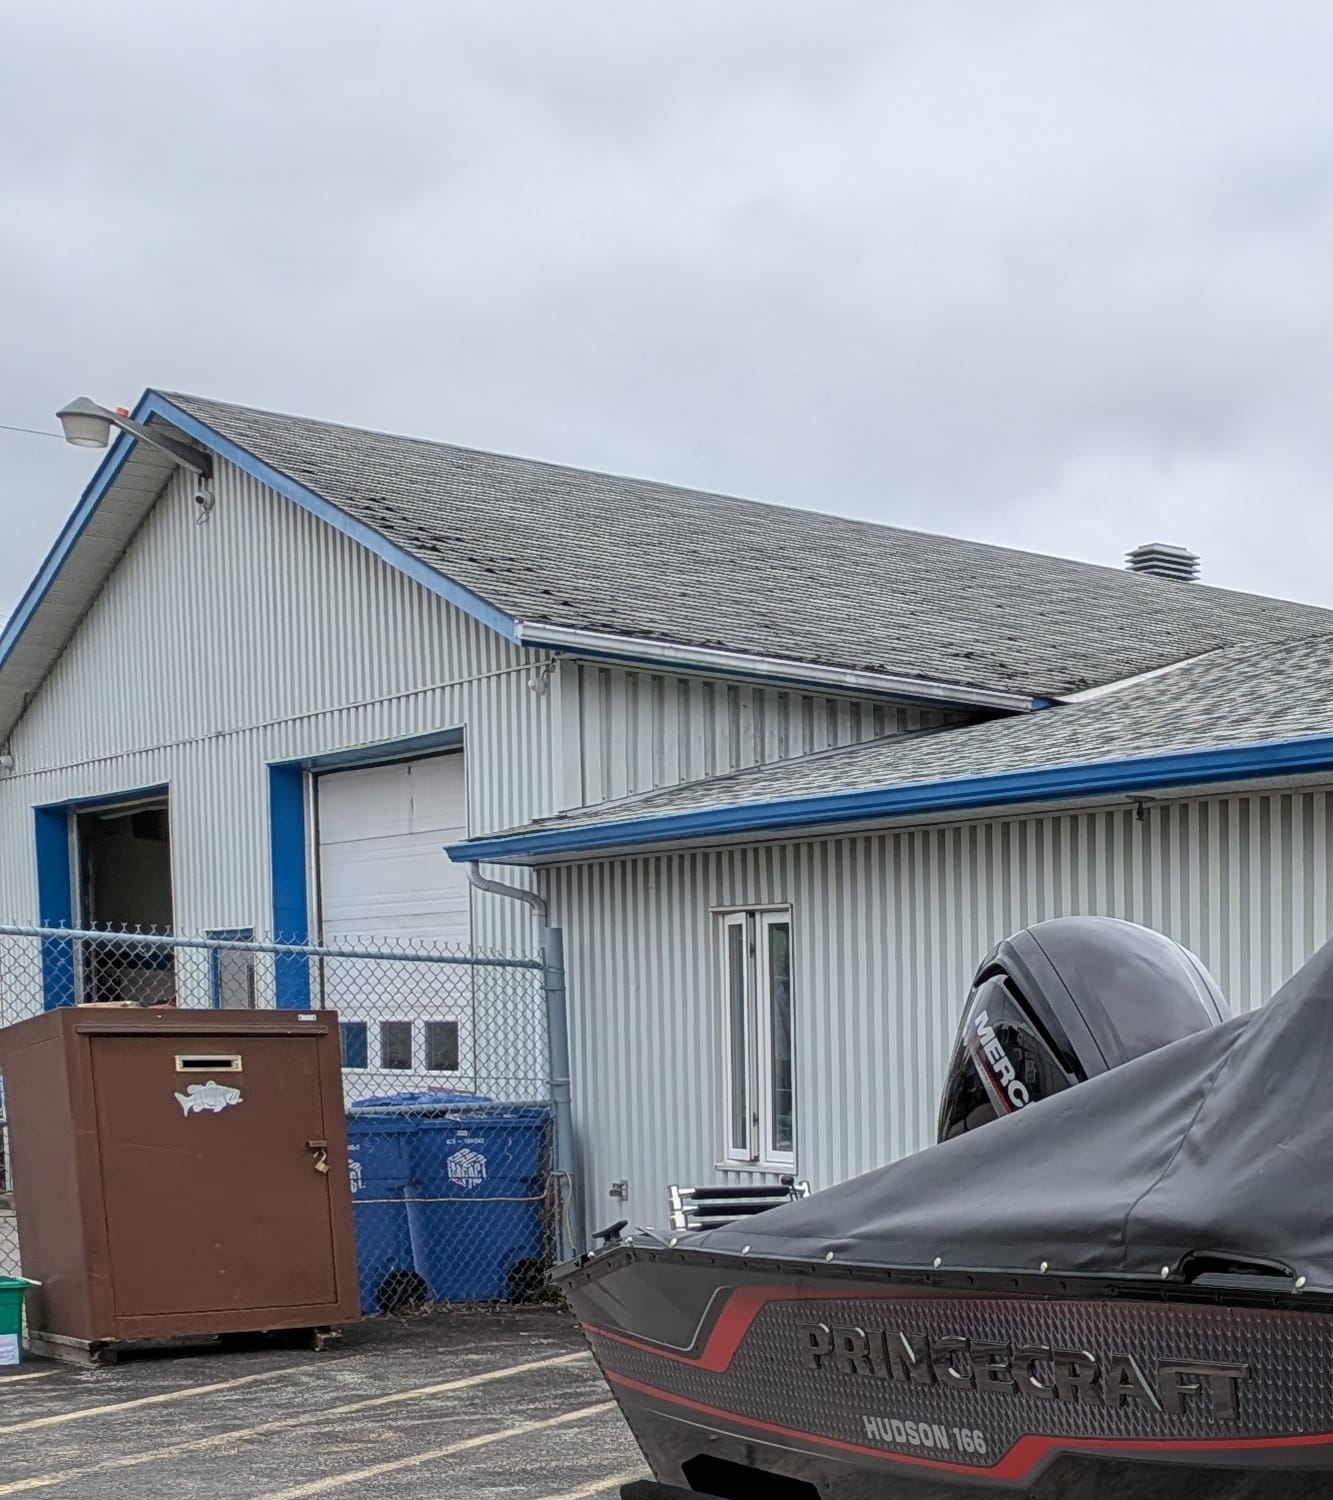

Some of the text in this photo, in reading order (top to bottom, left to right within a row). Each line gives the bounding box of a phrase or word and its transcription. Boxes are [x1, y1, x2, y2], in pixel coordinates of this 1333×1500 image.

[797, 1321, 1249, 1420] PRINCECRAFT
[862, 1415, 987, 1454] HUDSON 166
